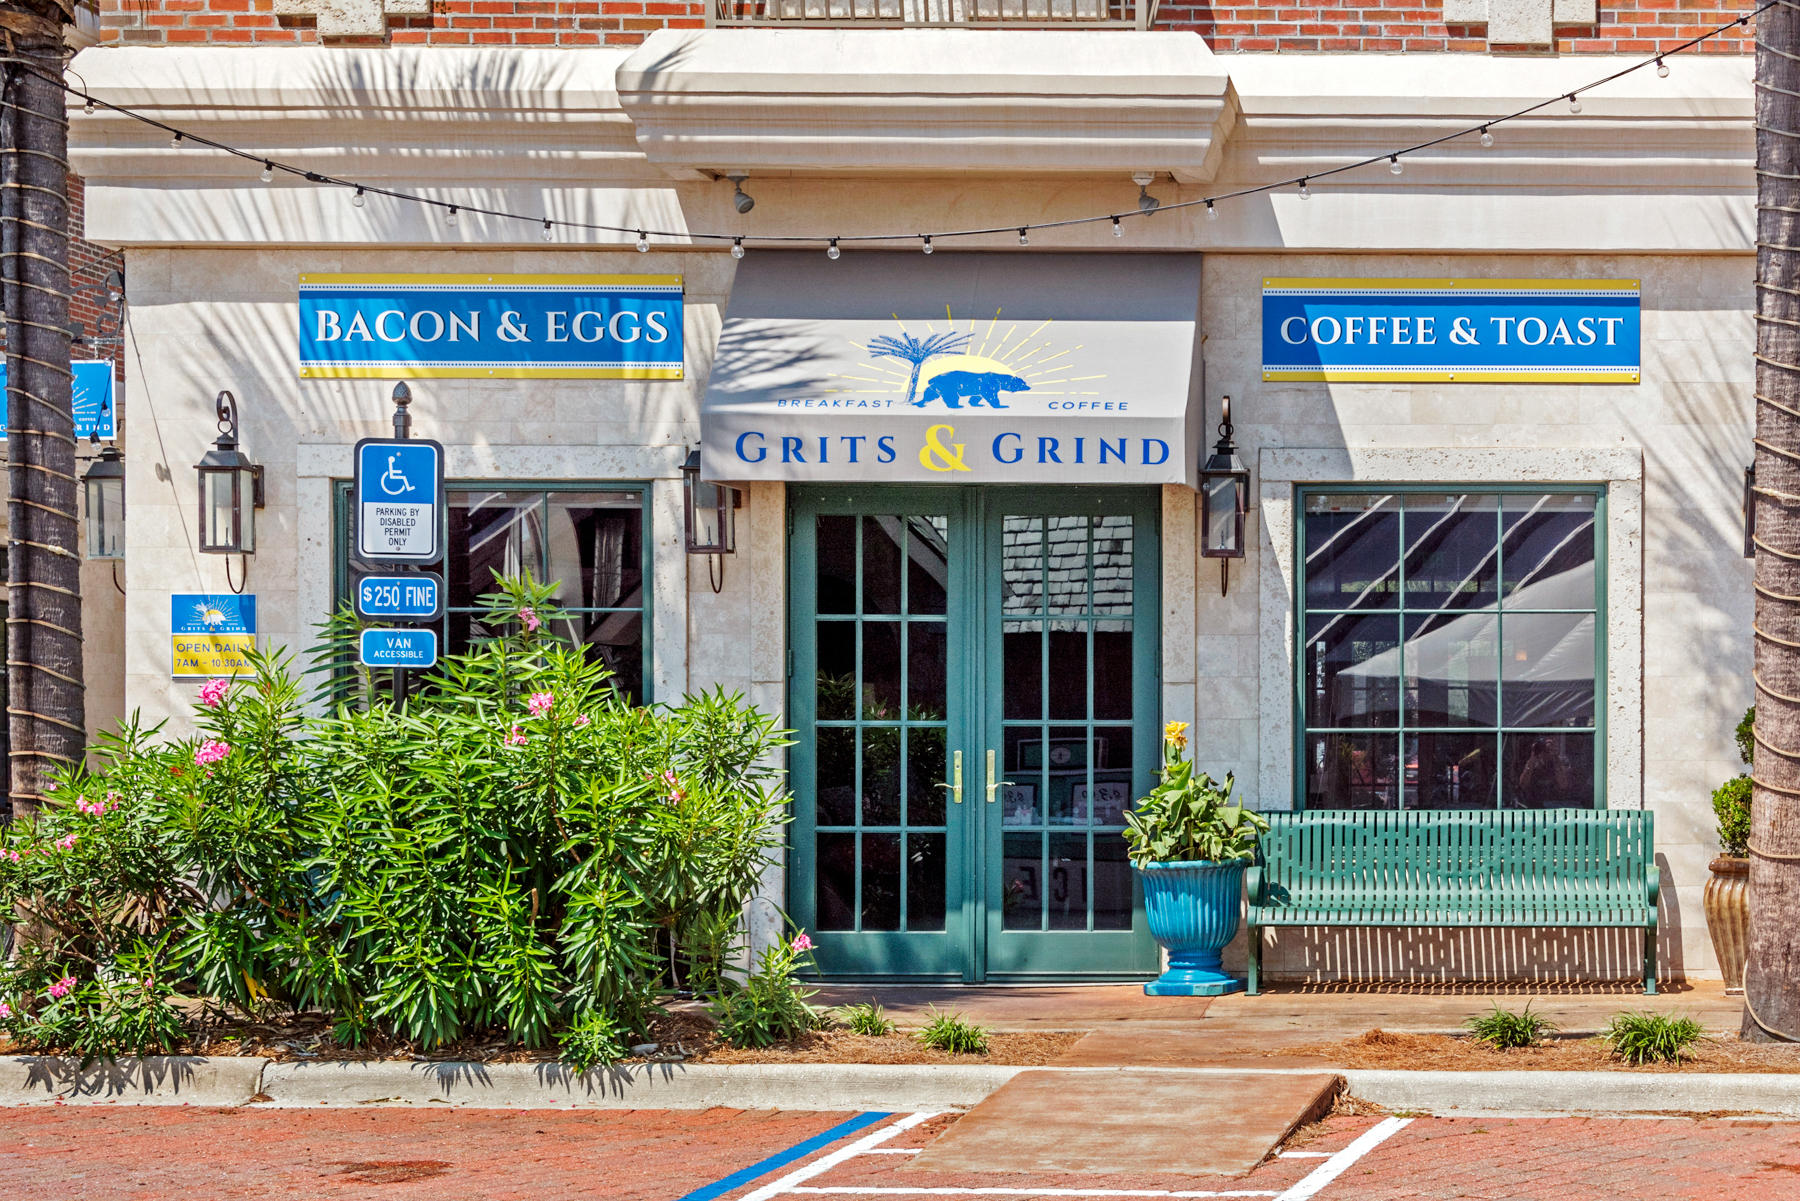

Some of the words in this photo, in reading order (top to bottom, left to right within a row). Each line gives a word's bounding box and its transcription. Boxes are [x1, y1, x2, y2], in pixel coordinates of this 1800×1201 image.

[314, 309, 482, 343] BACON
[495, 310, 533, 343] &
[544, 310, 670, 344] EGGS
[1279, 315, 1438, 346] COFFEE
[1448, 316, 1481, 346] &
[1489, 316, 1625, 346] TOAST
[776, 399, 895, 409] BREAKFAST
[1047, 401, 1130, 411] COFFEE
[734, 431, 897, 464] GRITS
[917, 423, 973, 472] &
[991, 431, 1170, 466] GRIND
[375, 507, 407, 517] PARKING
[410, 508, 420, 517] BY
[379, 517, 416, 527] DISABLED
[384, 527, 411, 536] PERMIT
[388, 537, 407, 546] ONLY
[363, 585, 400, 607] $250
[405, 586, 434, 607] FINE
[176, 643, 210, 653] OPEN
[214, 643, 252, 653] DAILY
[386, 638, 412, 649] VAN
[373, 650, 424, 659] ACCESSIBLE
[176, 658, 199, 667] 7AM
